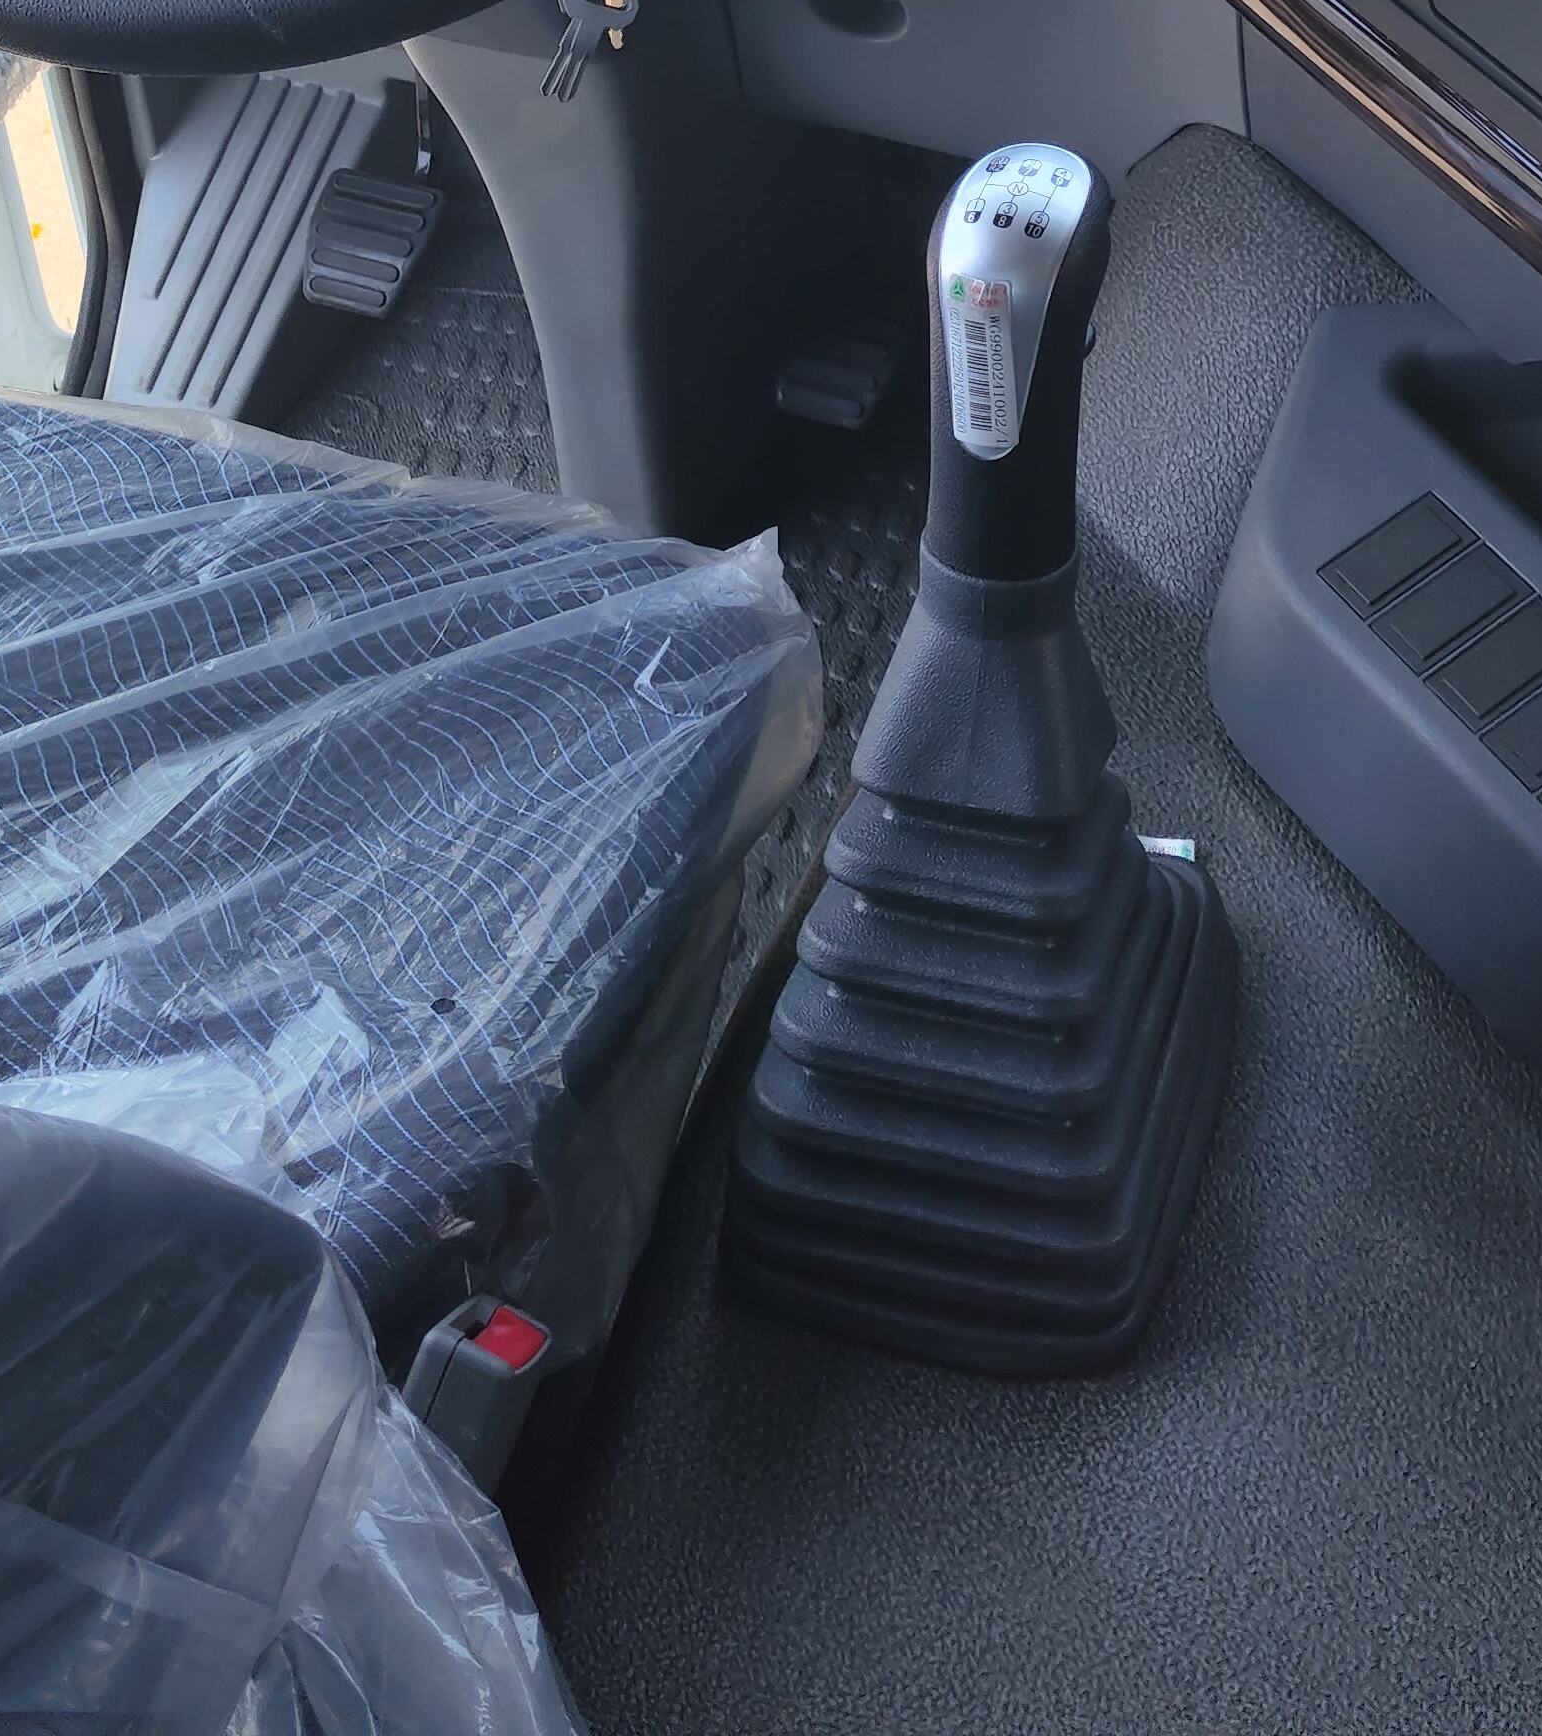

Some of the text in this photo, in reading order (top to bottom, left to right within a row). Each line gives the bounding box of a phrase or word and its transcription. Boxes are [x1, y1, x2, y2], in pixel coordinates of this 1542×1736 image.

[1013, 184, 1024, 194] N
[1003, 204, 1012, 214] 3
[998, 215, 1007, 226] 8
[1035, 214, 1045, 224] 5
[1027, 224, 1042, 236] 10
[989, 315, 1009, 444] WG9900241002/1
